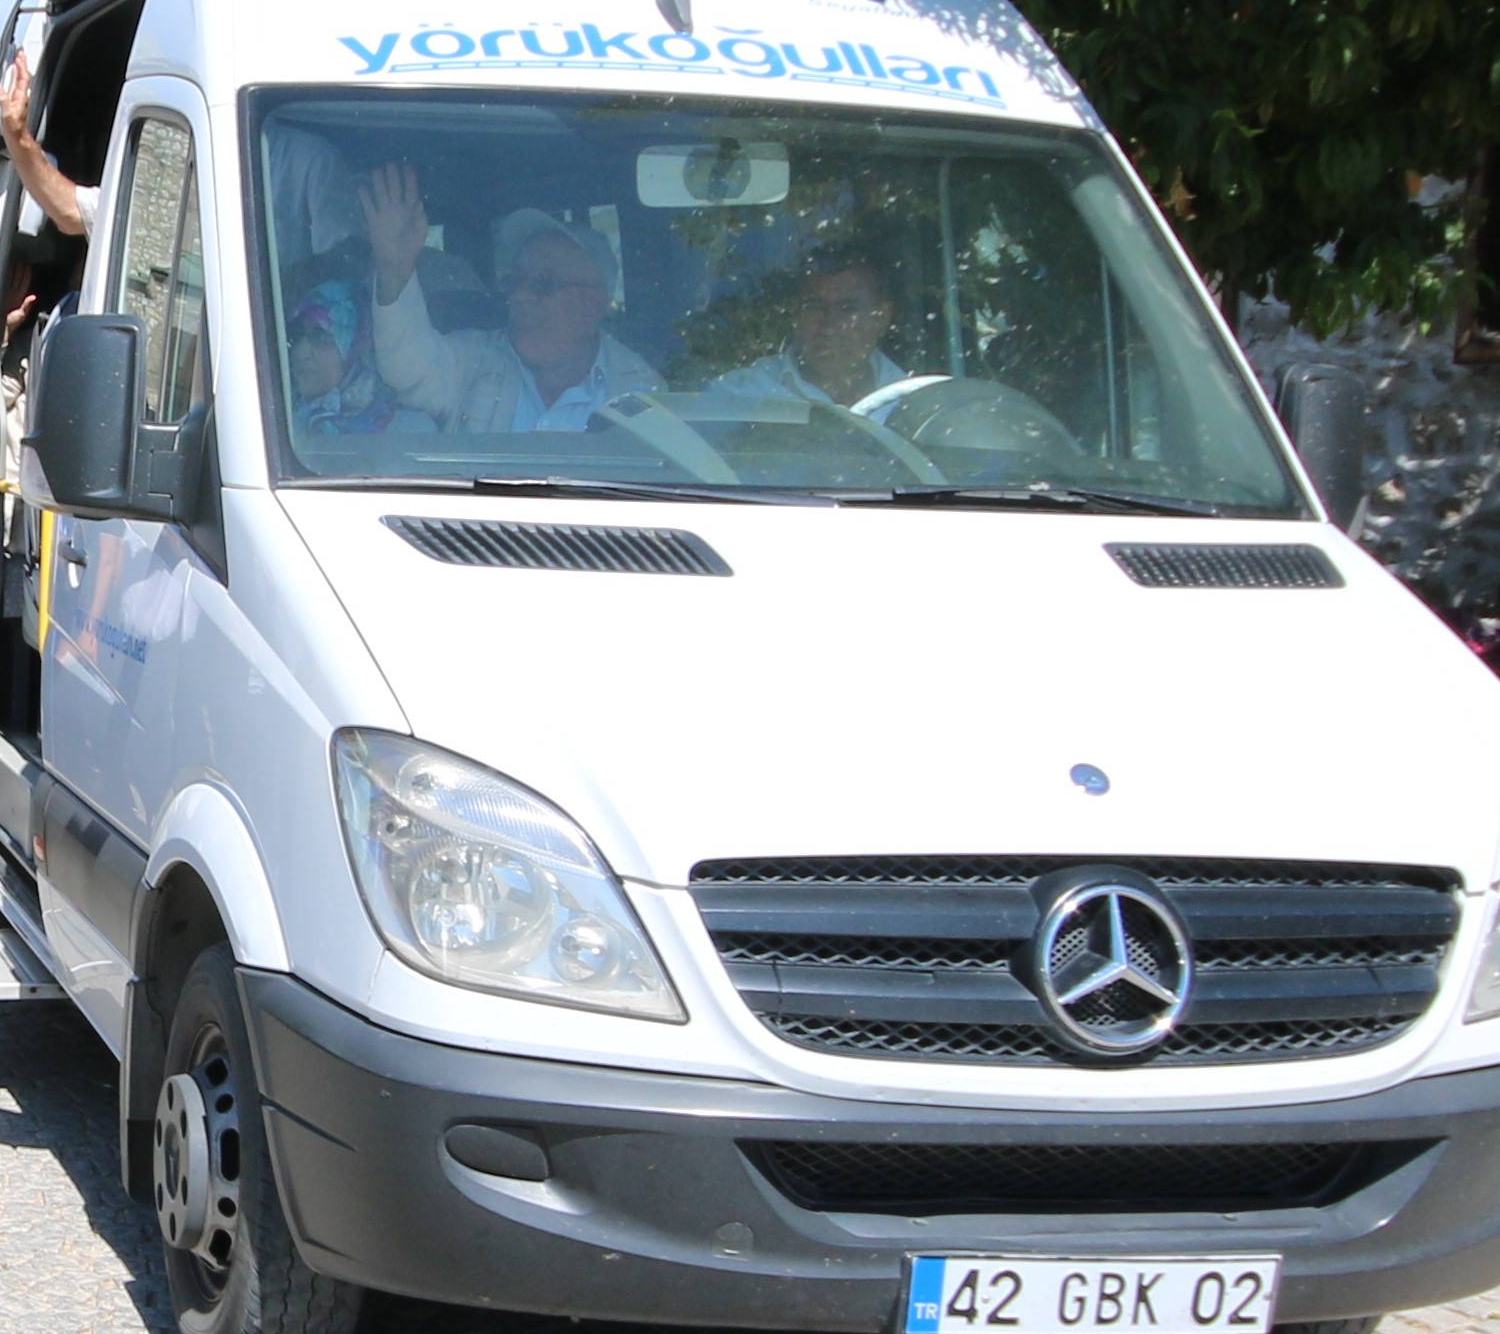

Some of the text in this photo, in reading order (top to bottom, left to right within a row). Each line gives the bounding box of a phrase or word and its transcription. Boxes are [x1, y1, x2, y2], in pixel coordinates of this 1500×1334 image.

[914, 1269, 1264, 1326] TR 42 GBK 02
